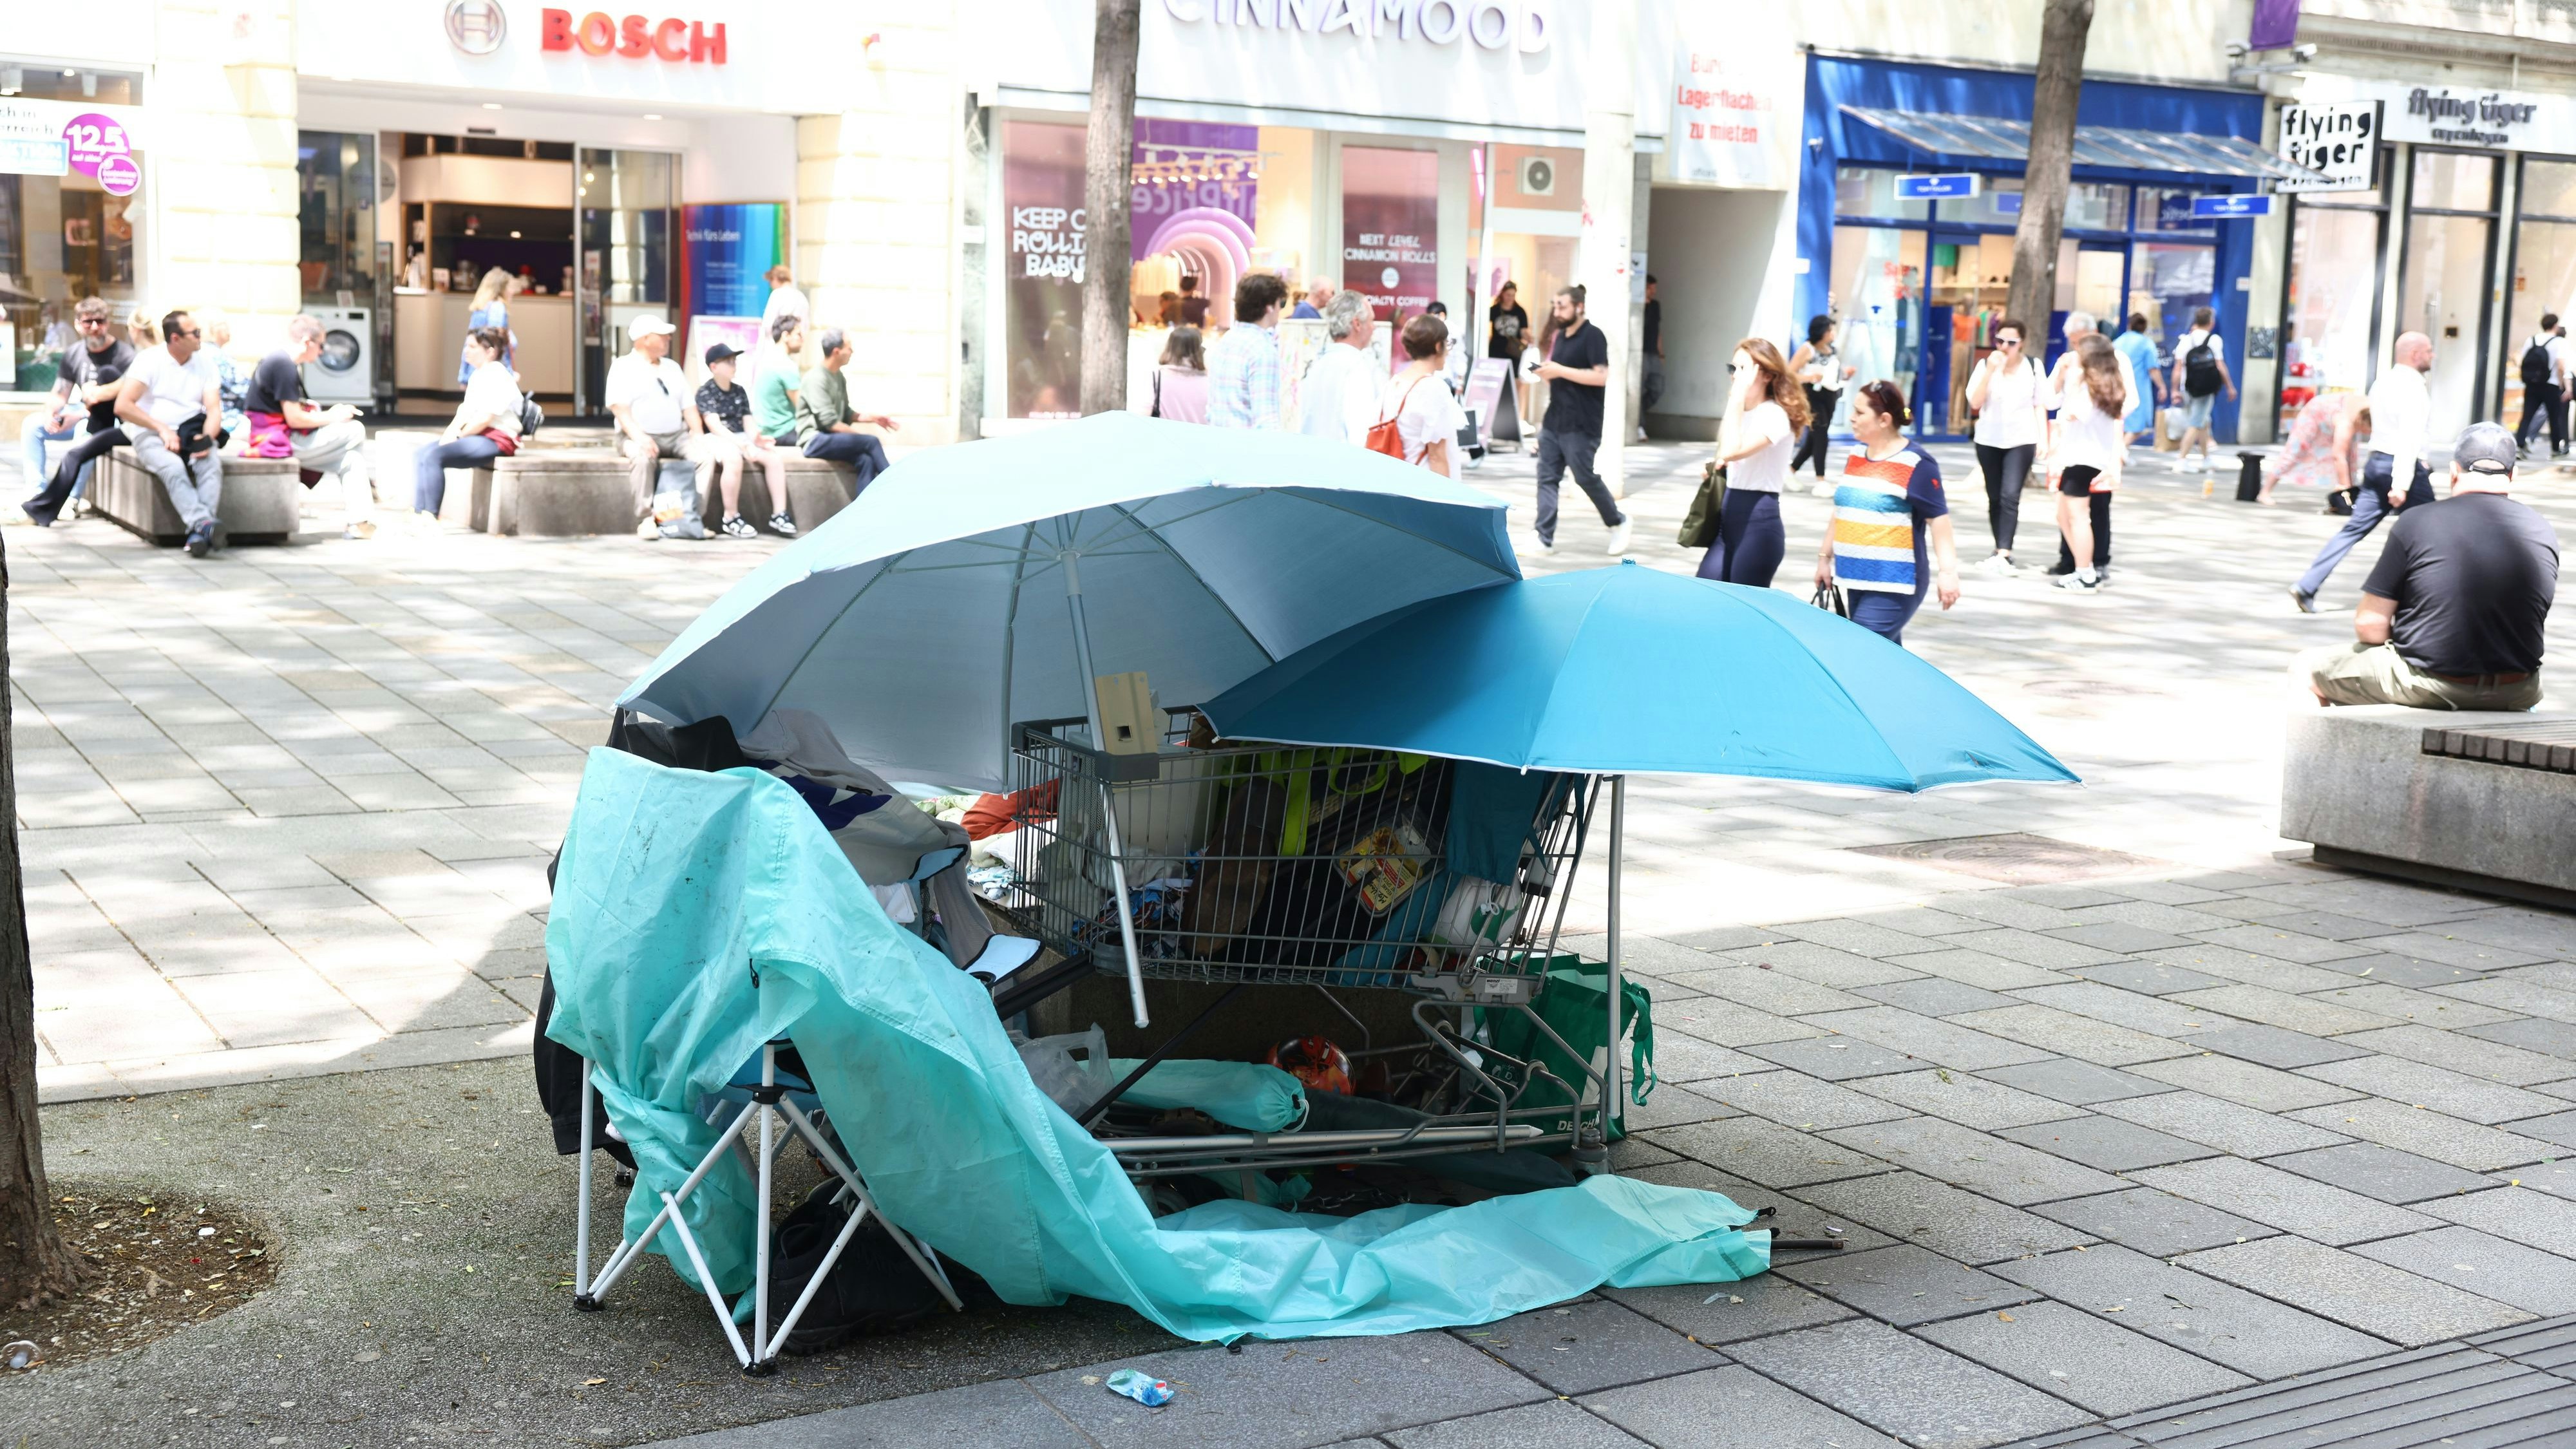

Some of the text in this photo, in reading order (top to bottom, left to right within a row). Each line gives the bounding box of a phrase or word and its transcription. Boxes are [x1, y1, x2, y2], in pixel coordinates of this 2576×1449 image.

[542, 8, 726, 64] BOSCH
[2409, 88, 2475, 124] flying
[1690, 121, 1757, 143] zu mieten
[2286, 106, 2371, 141] flying
[2290, 139, 2363, 171] tiger
[1013, 206, 1067, 230] KEEP
[1013, 231, 1086, 254] ROLLI
[1359, 234, 1421, 248] NEXT LEVEL
[1026, 254, 1086, 283] BABY
[1344, 248, 1435, 263] CINNAMON ROLLS
